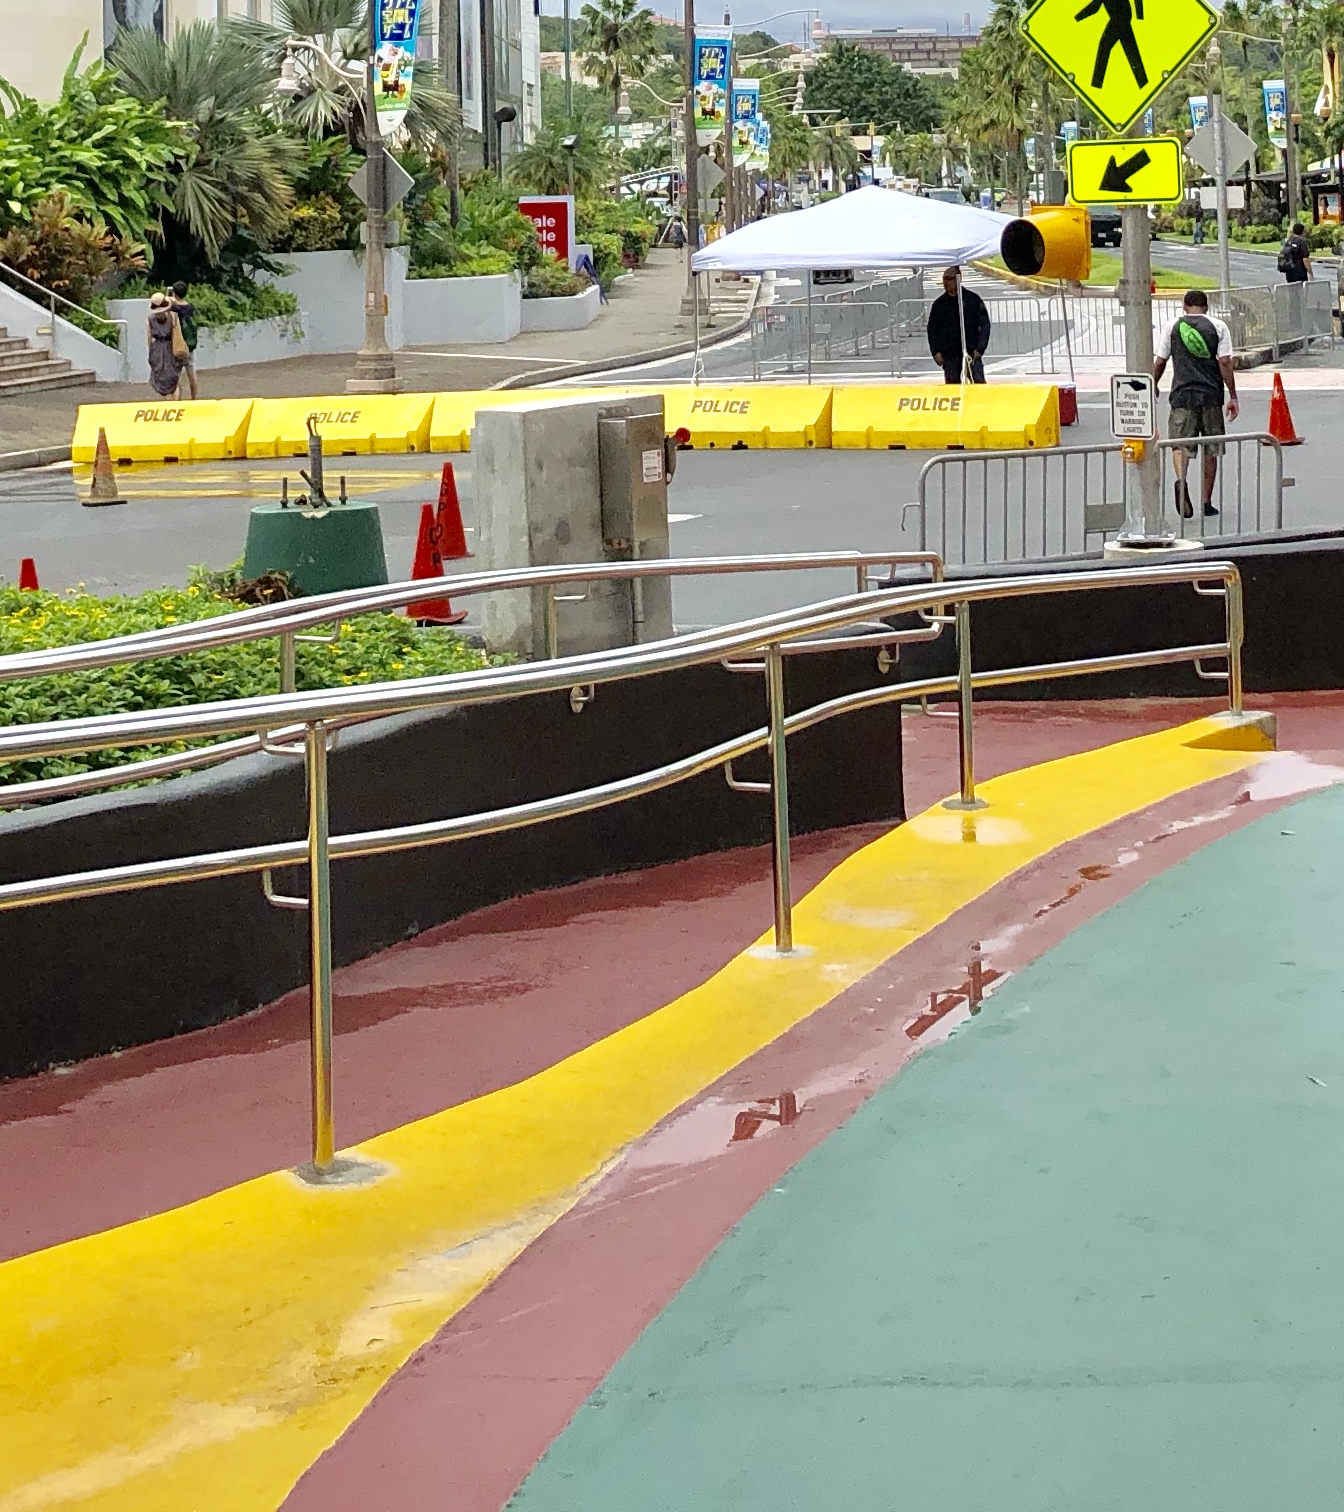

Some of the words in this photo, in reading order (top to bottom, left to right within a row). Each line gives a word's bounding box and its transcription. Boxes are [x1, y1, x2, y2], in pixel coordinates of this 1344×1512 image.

[533, 215, 556, 227] ale
[542, 229, 556, 242] le
[690, 399, 751, 415] POLICE
[897, 396, 961, 412] POLICE
[134, 408, 186, 423] POLICE
